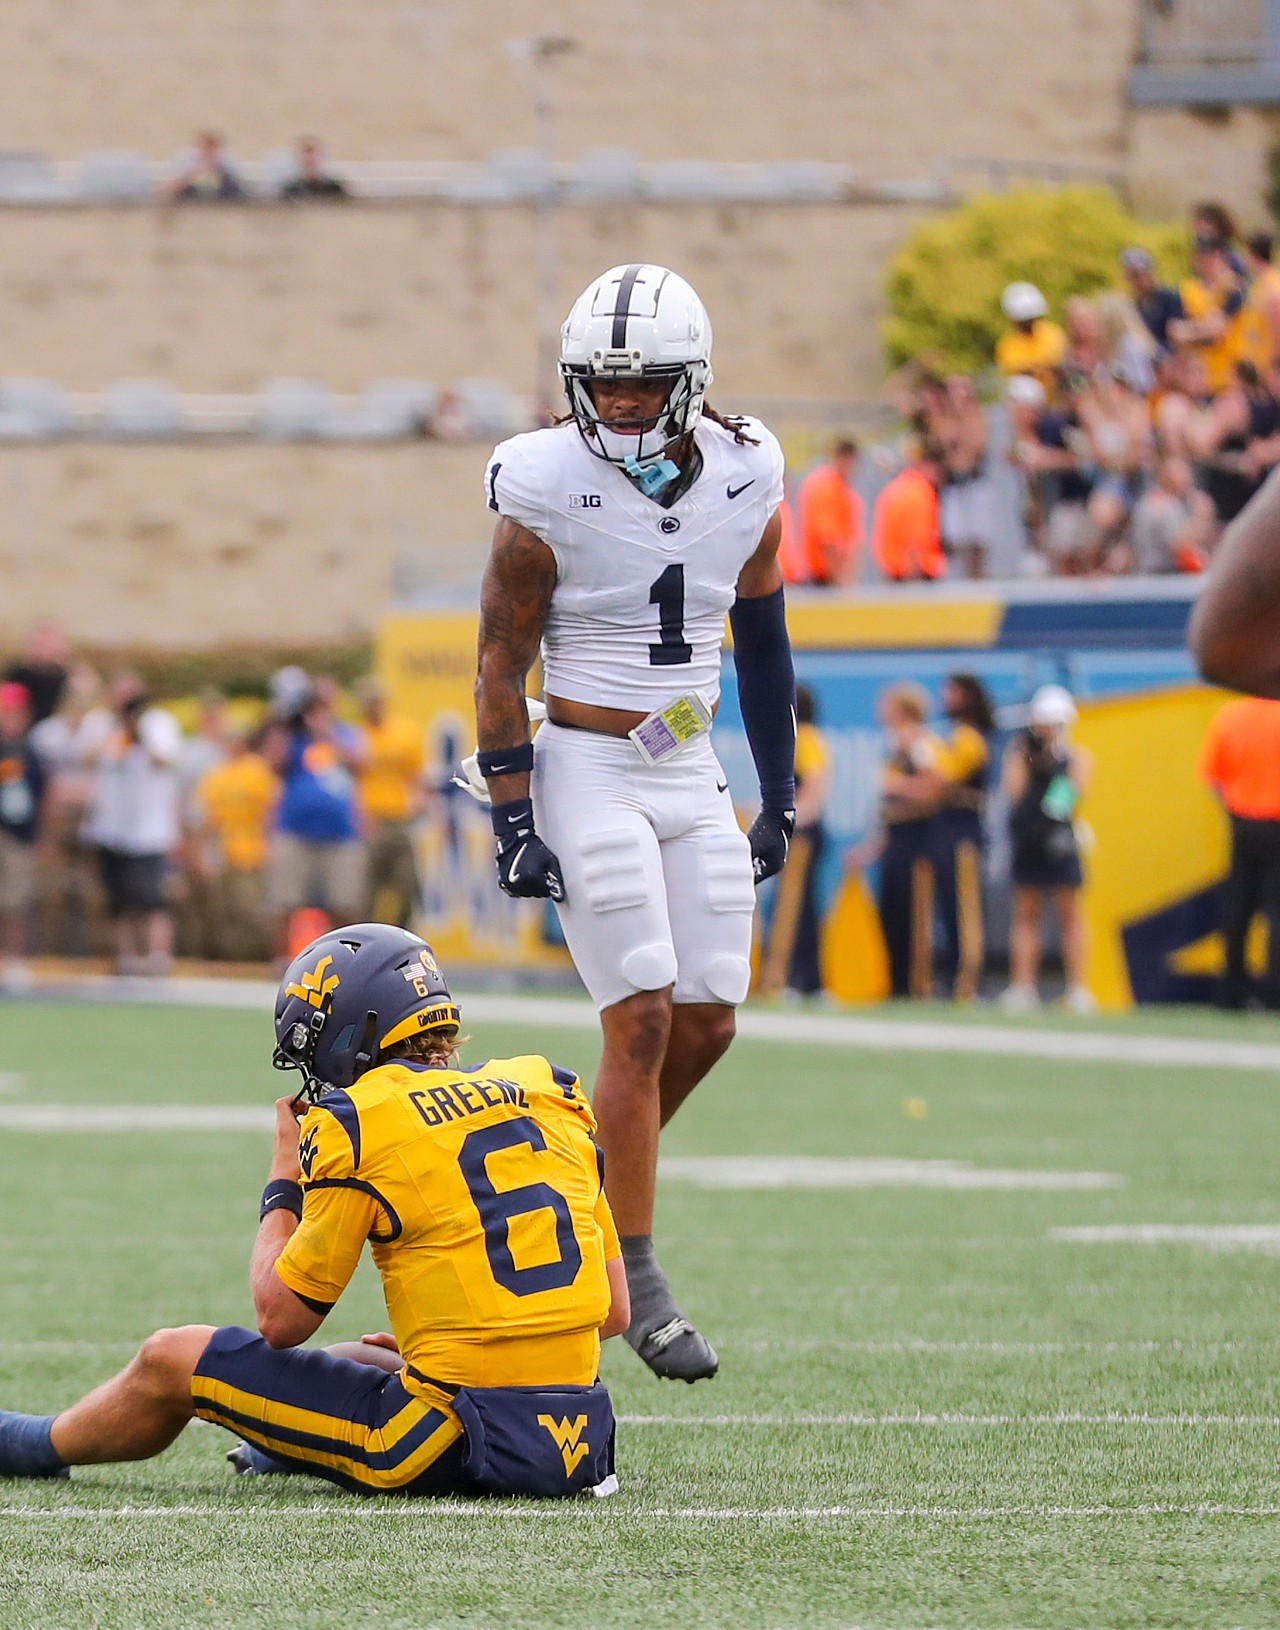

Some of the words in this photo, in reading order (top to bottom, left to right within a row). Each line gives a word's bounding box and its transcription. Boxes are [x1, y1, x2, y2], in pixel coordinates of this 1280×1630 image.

[489, 462, 503, 512] 1
[648, 563, 693, 666] 1
[412, 976, 429, 998] 6
[457, 1116, 583, 1297] 6
